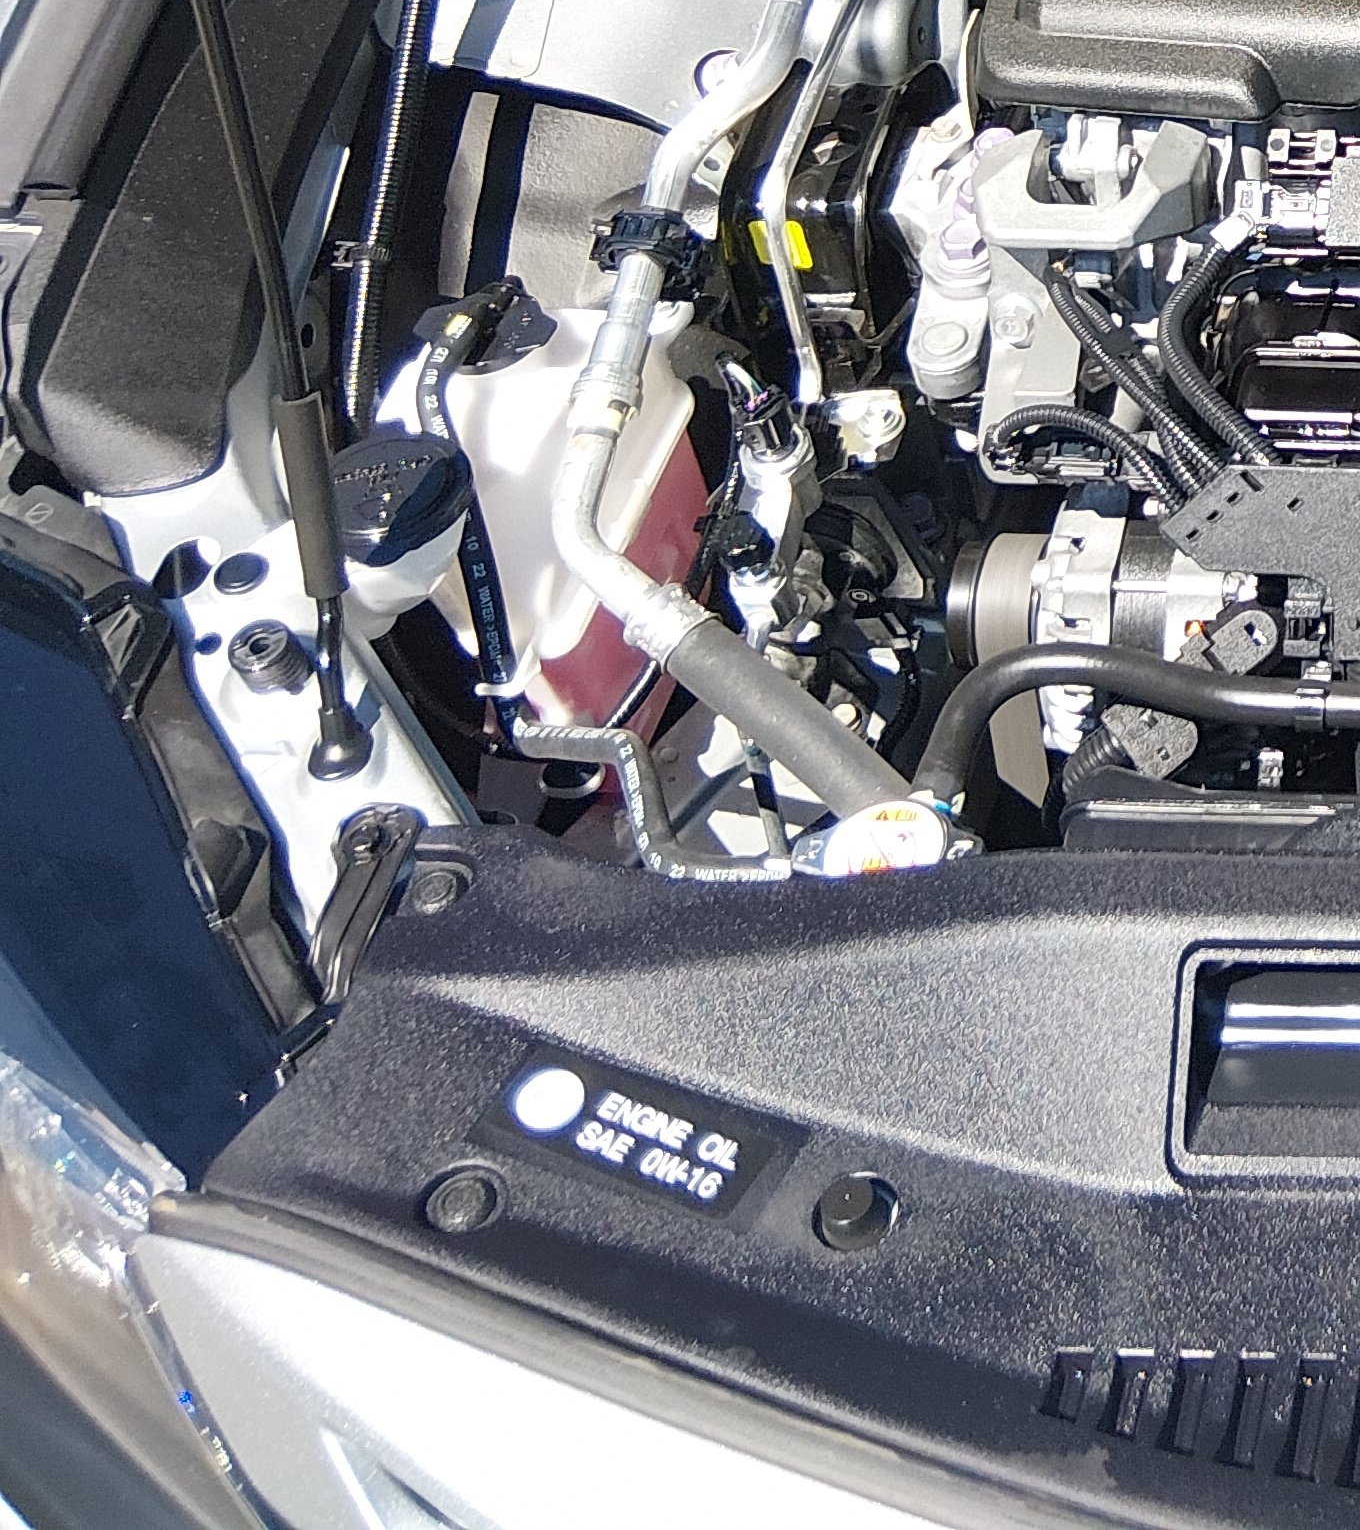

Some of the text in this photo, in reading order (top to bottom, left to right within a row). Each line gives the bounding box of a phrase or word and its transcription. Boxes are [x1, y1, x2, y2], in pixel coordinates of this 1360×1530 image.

[424, 394, 438, 410] 22
[467, 536, 480, 551] 10
[471, 562, 487, 579] 22
[478, 585, 496, 622] WATER
[624, 758, 640, 793] WATER
[668, 863, 686, 879] 22
[596, 1091, 739, 1172] ENGINE OIL
[576, 1120, 723, 1199] SAE 0W-16
